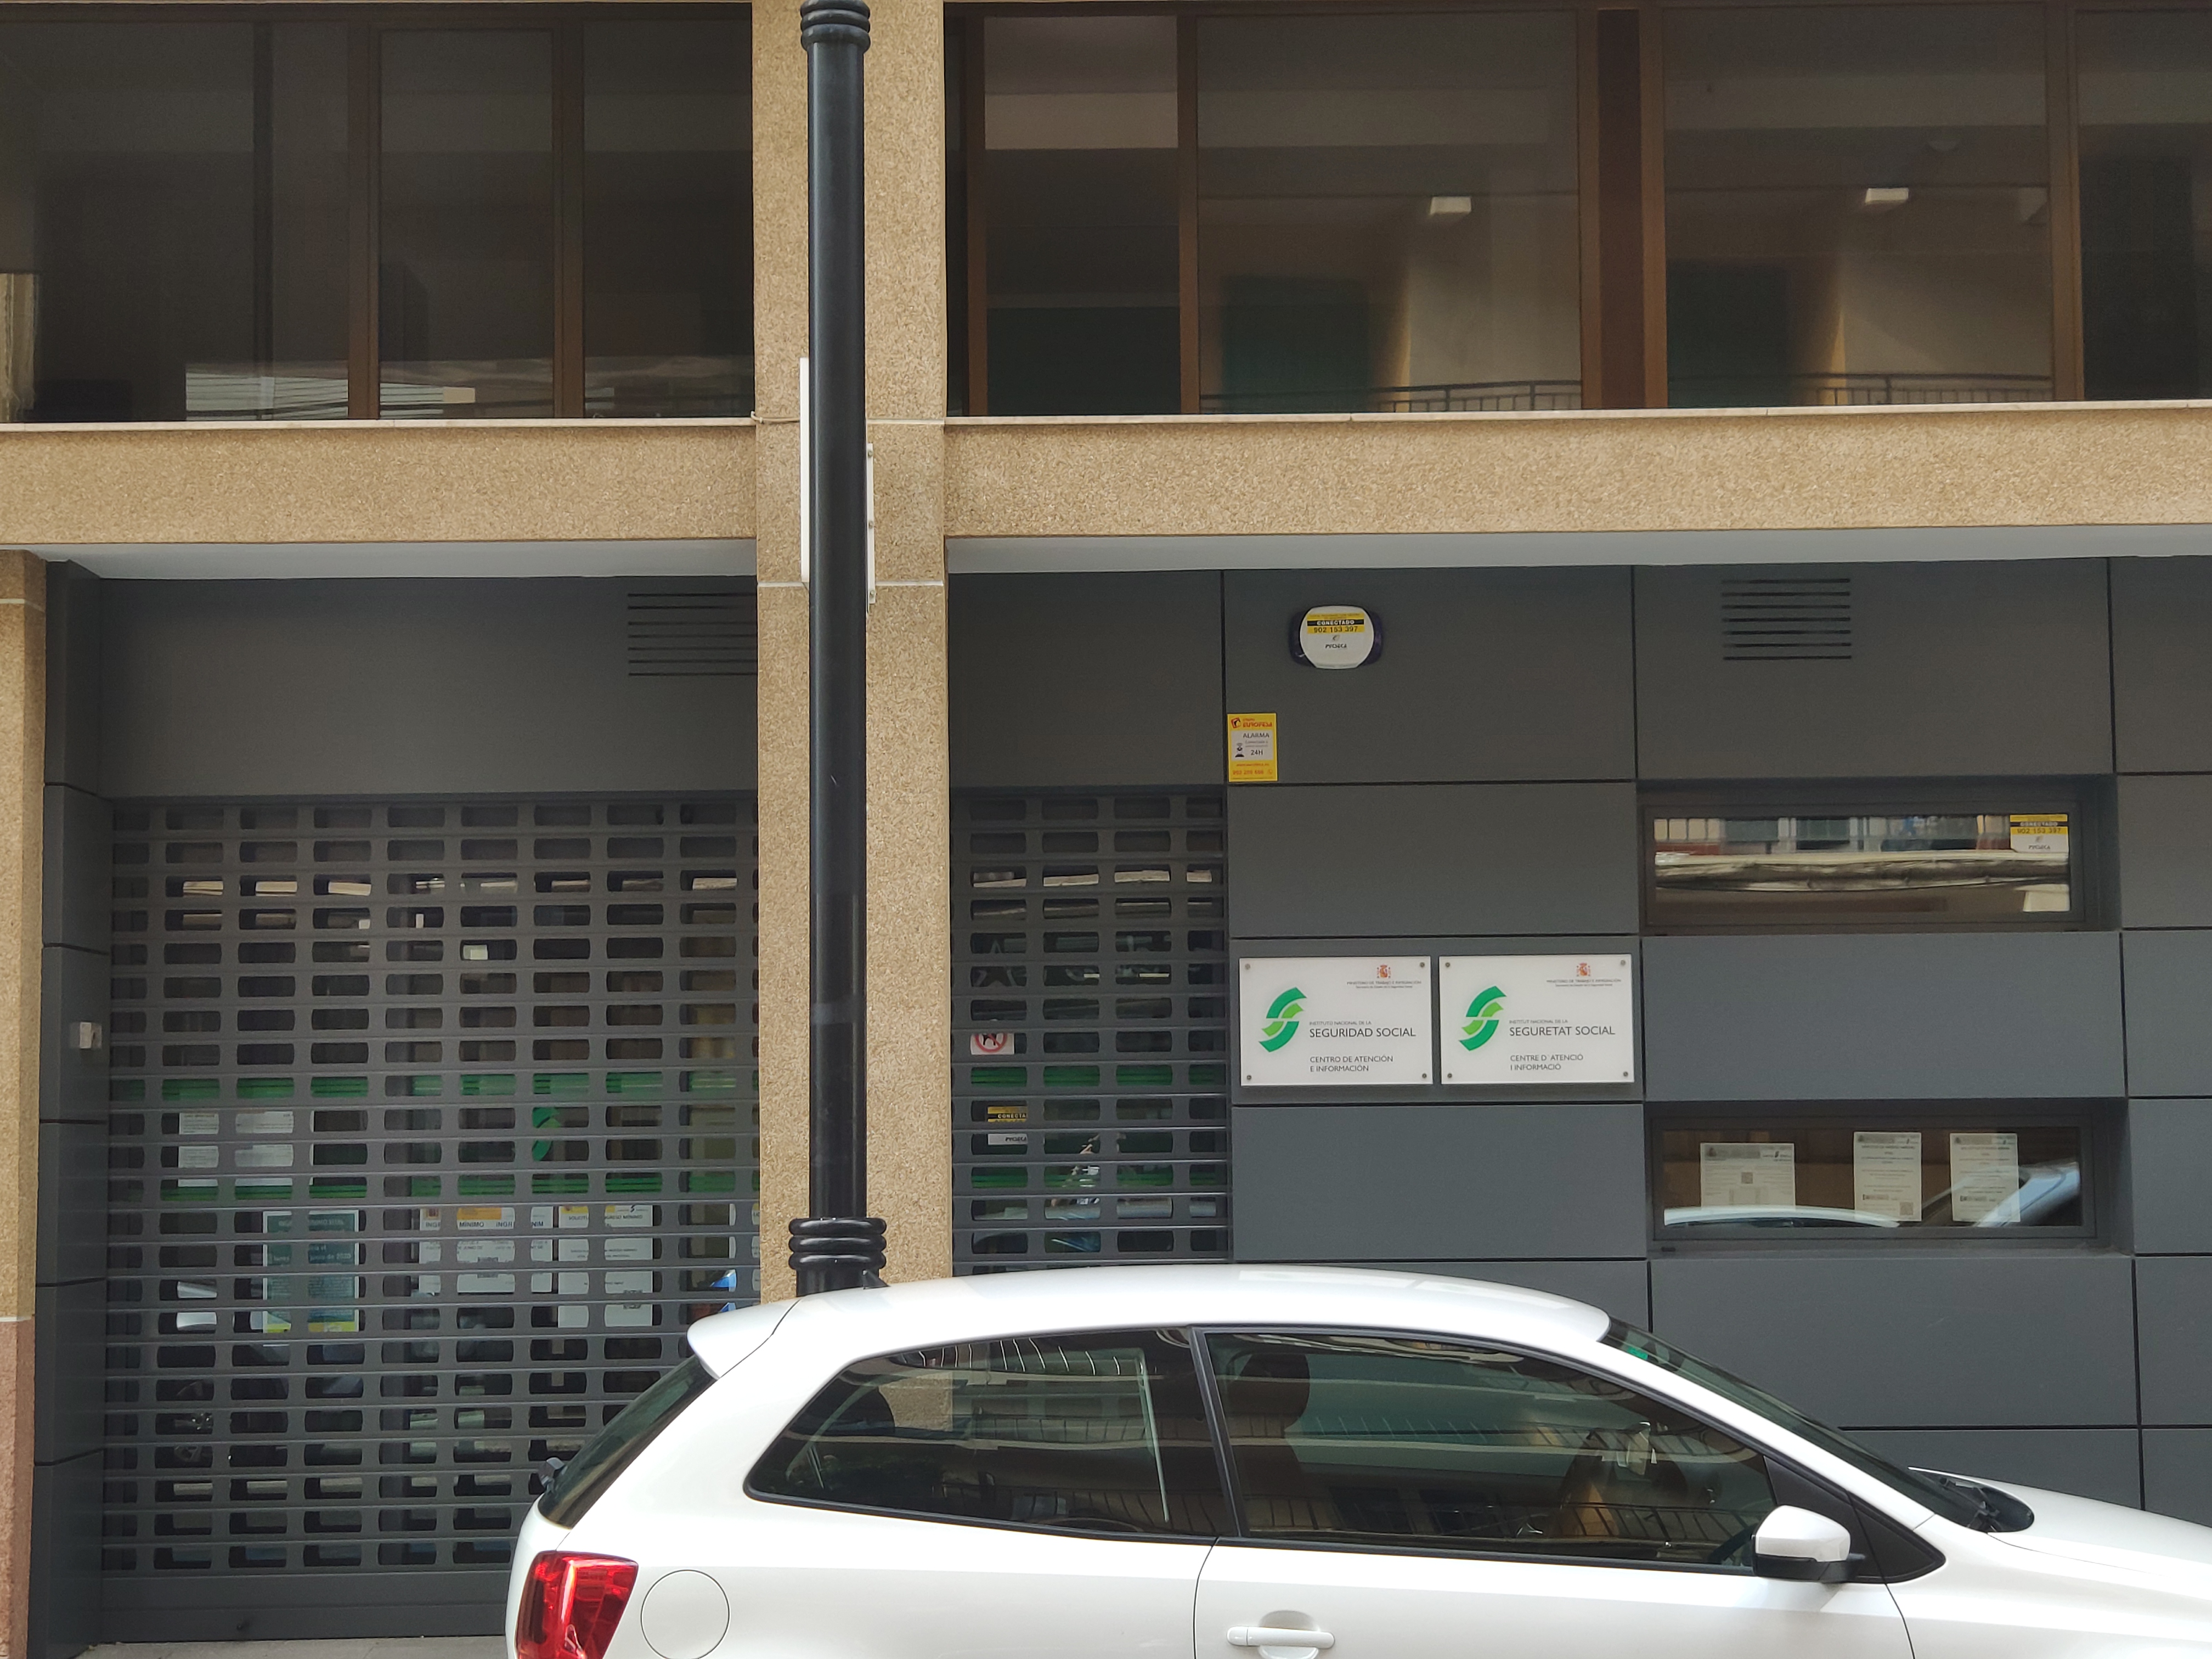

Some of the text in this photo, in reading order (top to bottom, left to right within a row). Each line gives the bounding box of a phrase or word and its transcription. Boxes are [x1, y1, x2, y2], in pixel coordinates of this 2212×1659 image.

[1310, 1027, 1417, 1038] SEGURIDAD SOCIAL
[1509, 1026, 1616, 1036] SEGURETAT SOCIAL
[1354, 1054, 1393, 1063] ATENCIÓN
[1316, 1063, 1369, 1072] INFORMACIÓN
[1514, 1063, 1561, 1071] INFORMACIÓ
